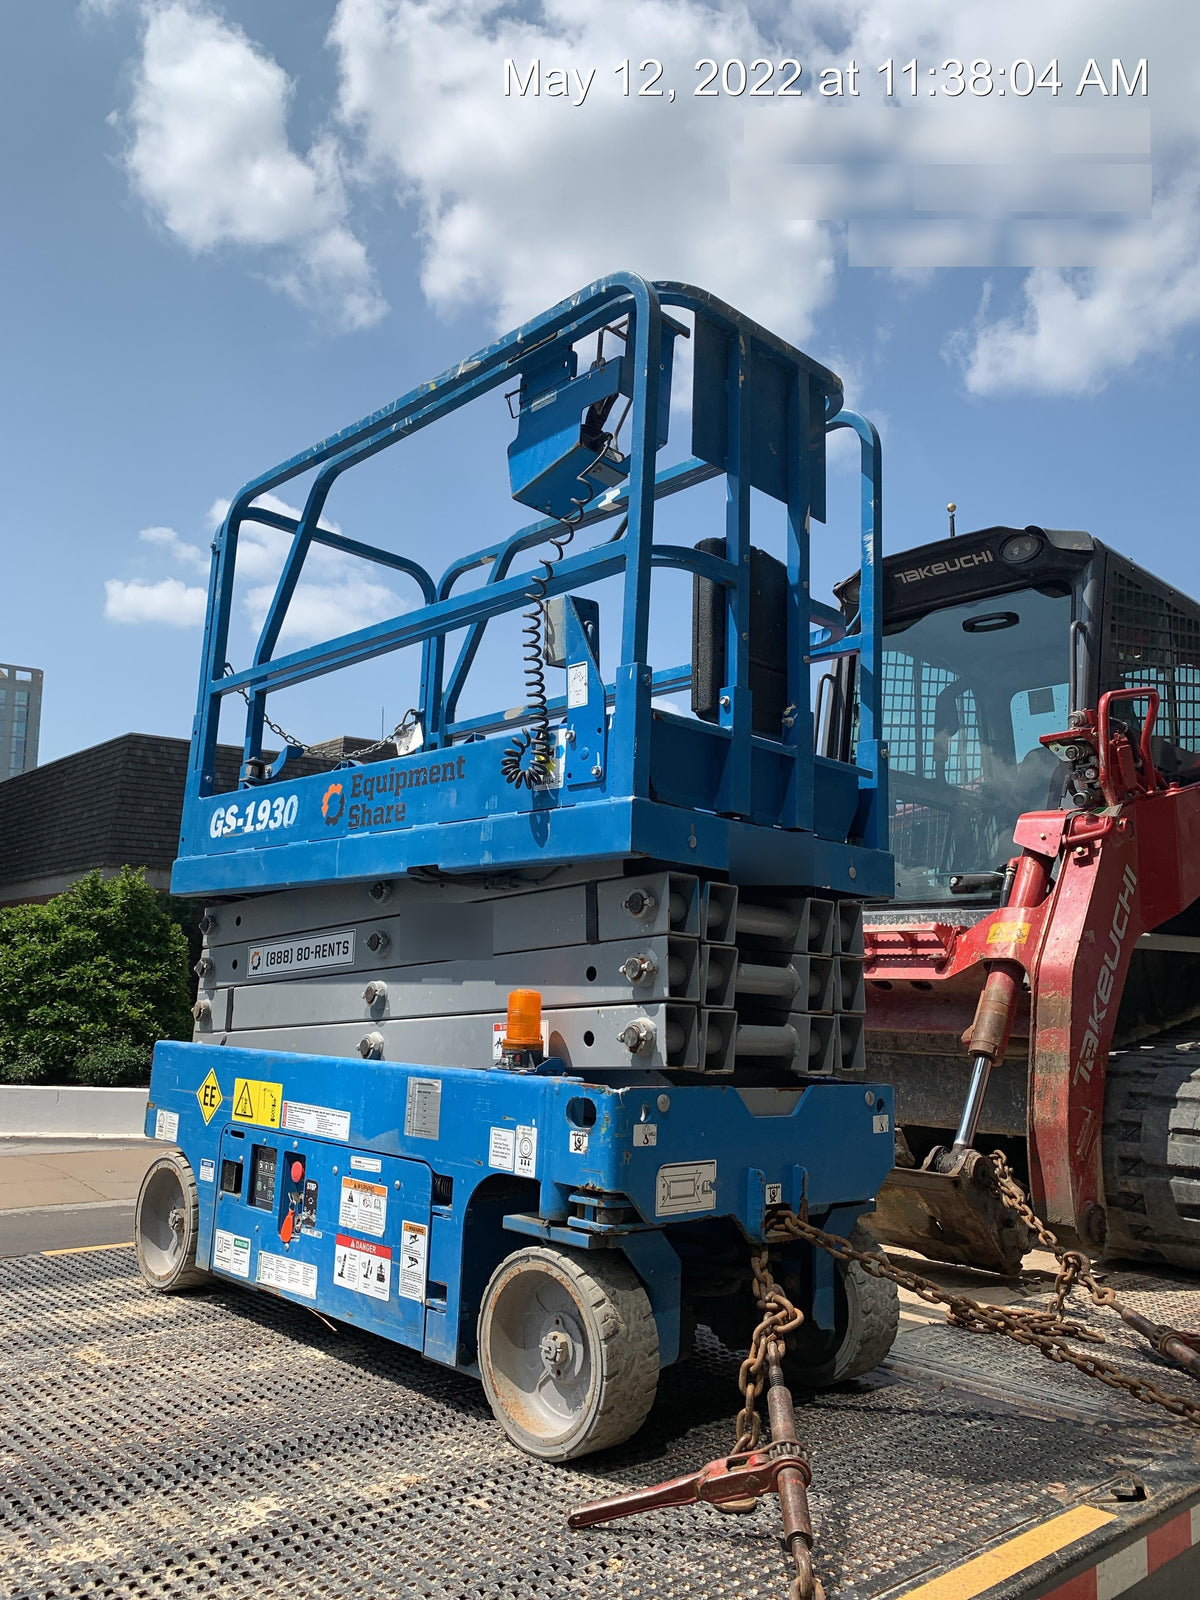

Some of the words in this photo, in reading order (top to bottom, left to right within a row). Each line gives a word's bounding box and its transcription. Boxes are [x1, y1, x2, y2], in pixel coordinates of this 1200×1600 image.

[350, 754, 466, 799] Equipment
[209, 794, 299, 839] GS-1930
[347, 800, 407, 830] Share
[265, 943, 294, 968] (888)
[296, 940, 350, 962] 80-RENTS
[203, 1085, 217, 1108] EE
[355, 1240, 377, 1254] DANGER
